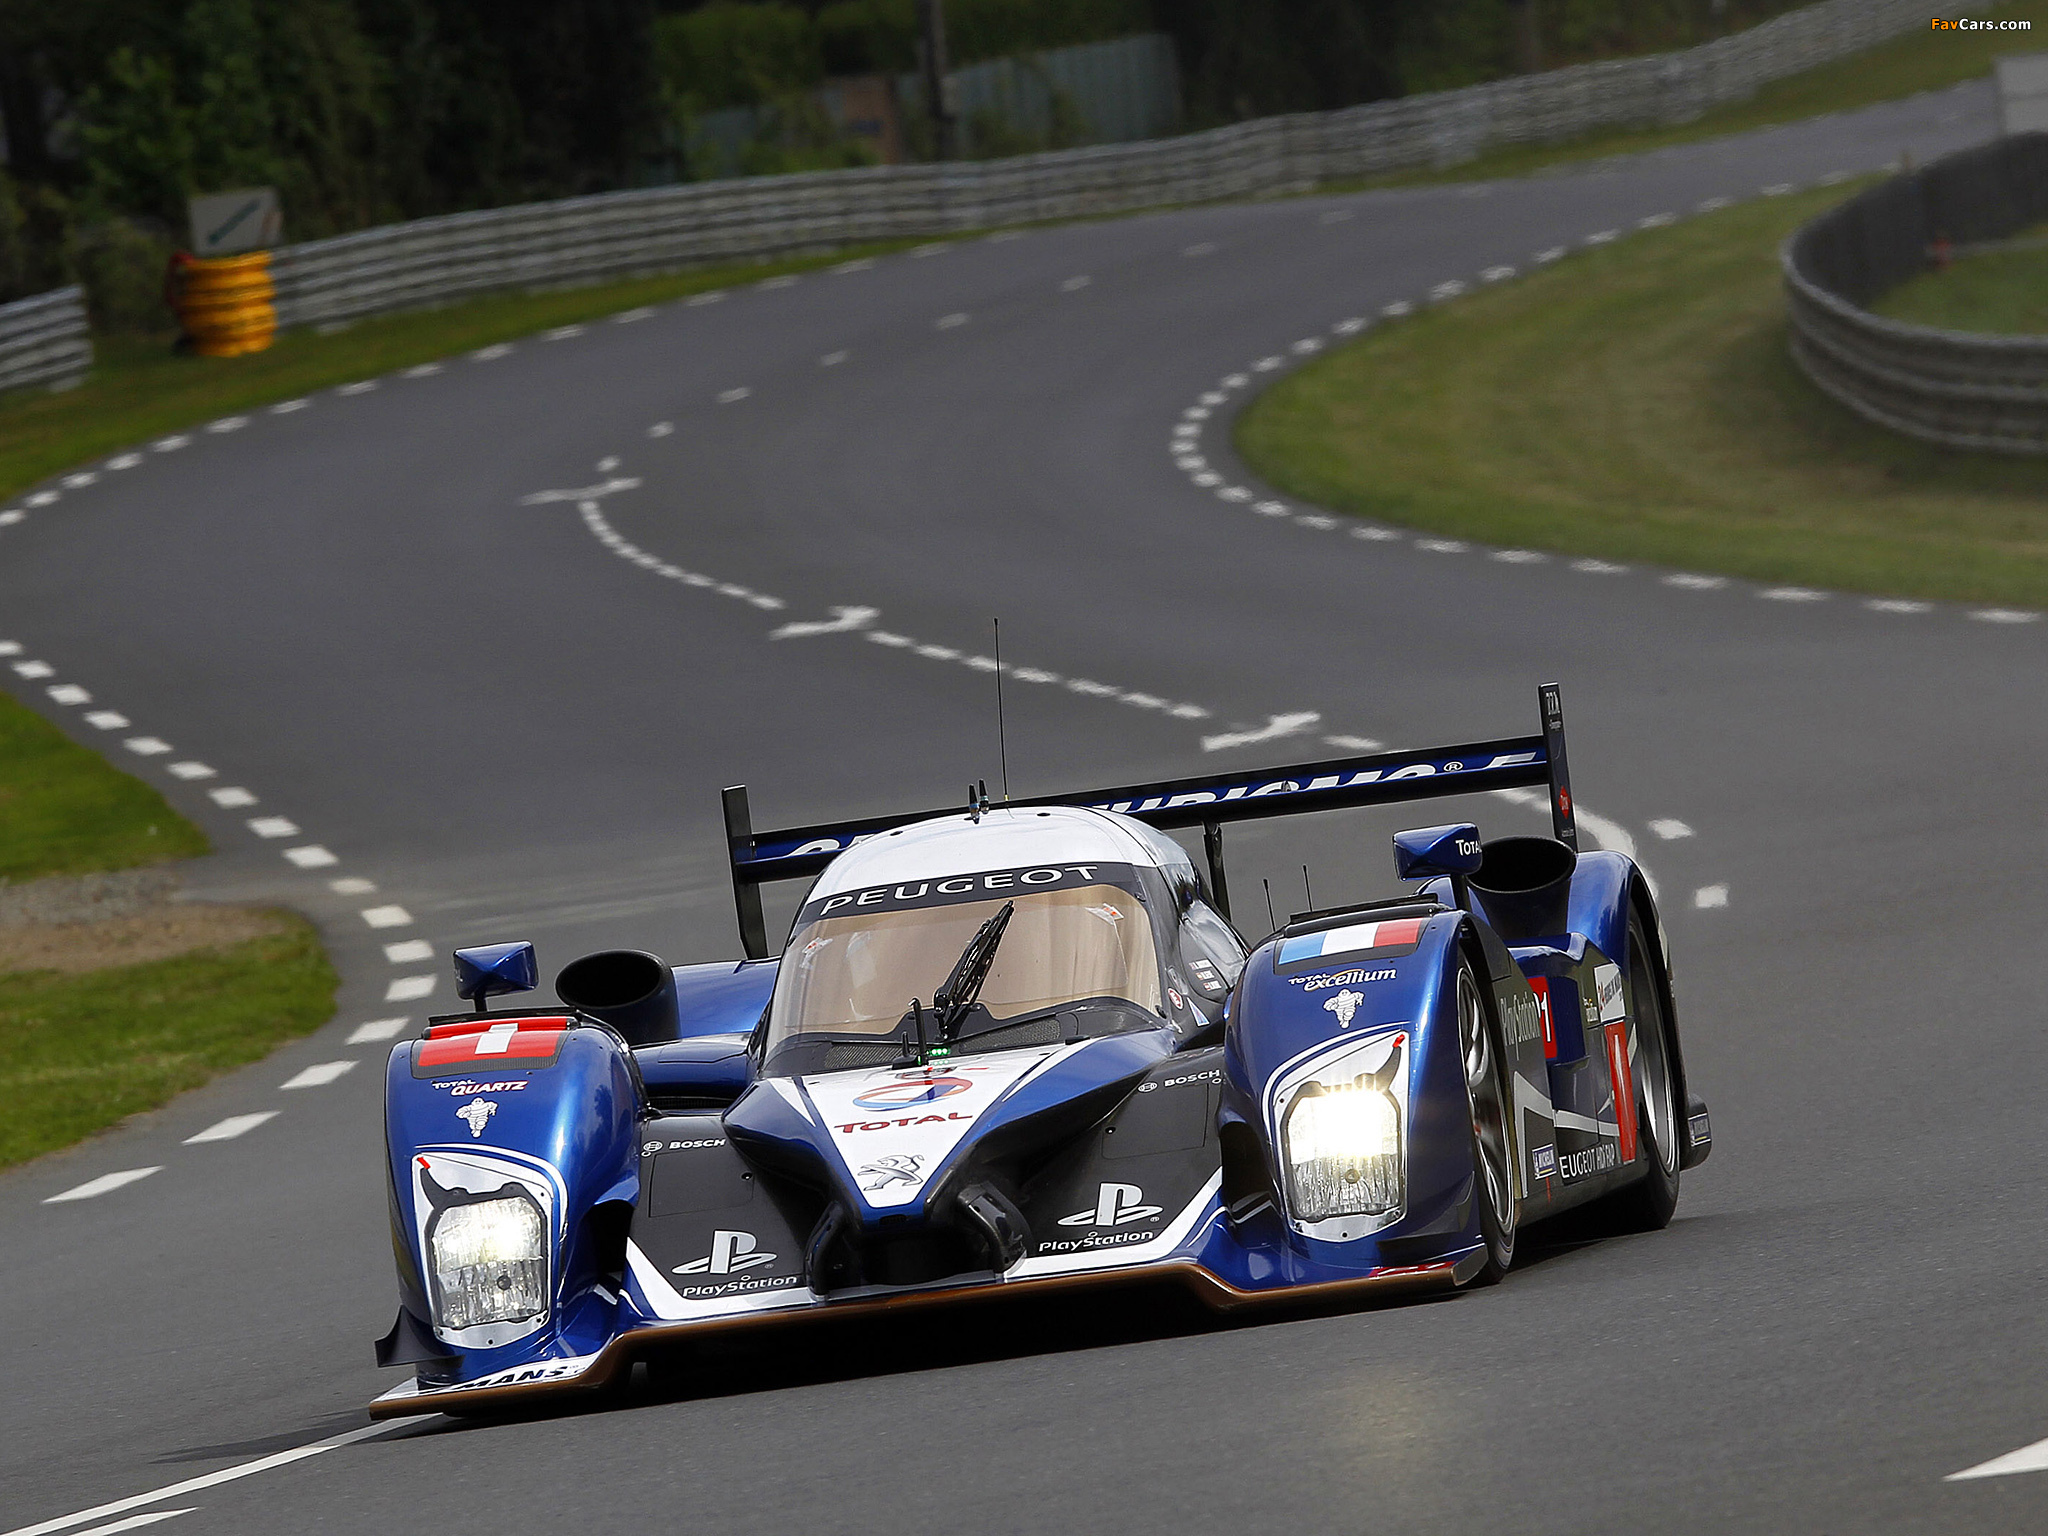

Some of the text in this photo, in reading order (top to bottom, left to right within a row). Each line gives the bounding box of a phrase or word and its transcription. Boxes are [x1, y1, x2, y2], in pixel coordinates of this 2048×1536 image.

[1455, 839, 1482, 856] TOTA
[820, 865, 1098, 916] PEUGEOT
[1288, 973, 1331, 985] TOTAL
[1303, 968, 1397, 992] excellium
[432, 1079, 476, 1090] TOTAL
[1164, 1069, 1220, 1087] BOSCH
[451, 1081, 529, 1096] QUARTZ
[834, 1112, 973, 1133] TOTAL
[669, 1138, 726, 1149] BOSCH
[1558, 1147, 1596, 1178] EUGEOT
[1038, 1231, 1154, 1252] PlayStation
[682, 1276, 798, 1298] PlayStation
